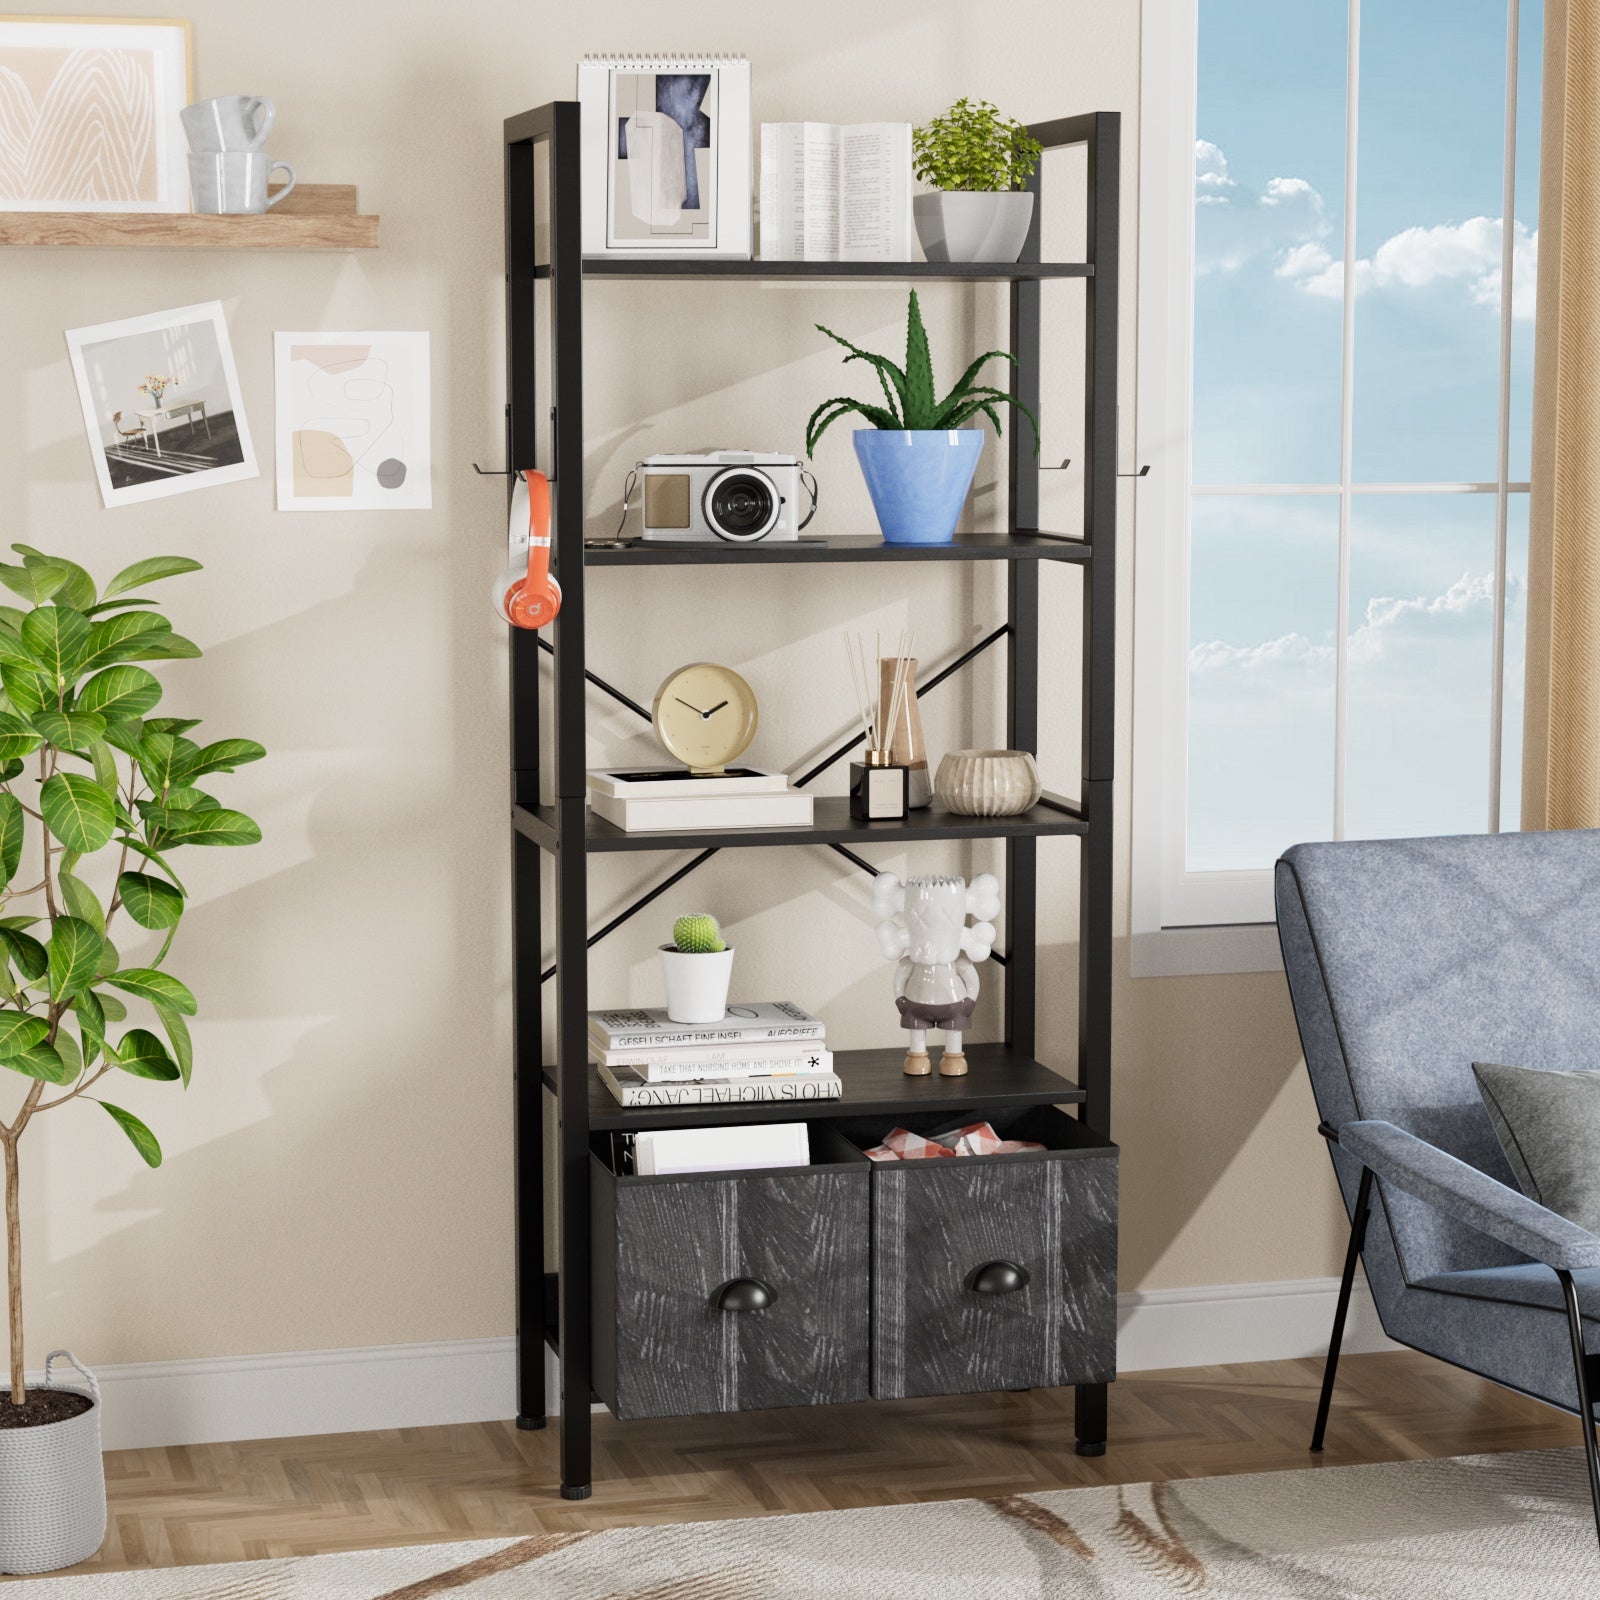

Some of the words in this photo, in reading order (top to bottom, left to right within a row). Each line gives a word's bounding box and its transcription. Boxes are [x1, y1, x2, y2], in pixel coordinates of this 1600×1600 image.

[660, 1064, 676, 1074] TAKE
[679, 1063, 695, 1074] THAT
[698, 1062, 729, 1073] NURSING
[731, 1060, 751, 1071] HOME
[753, 1060, 767, 1070] AND
[769, 1058, 793, 1069] SHOVE
[630, 1088, 689, 1106] JANG?
[692, 1084, 776, 1103] MICHAEL
[781, 1083, 797, 1099] IS
